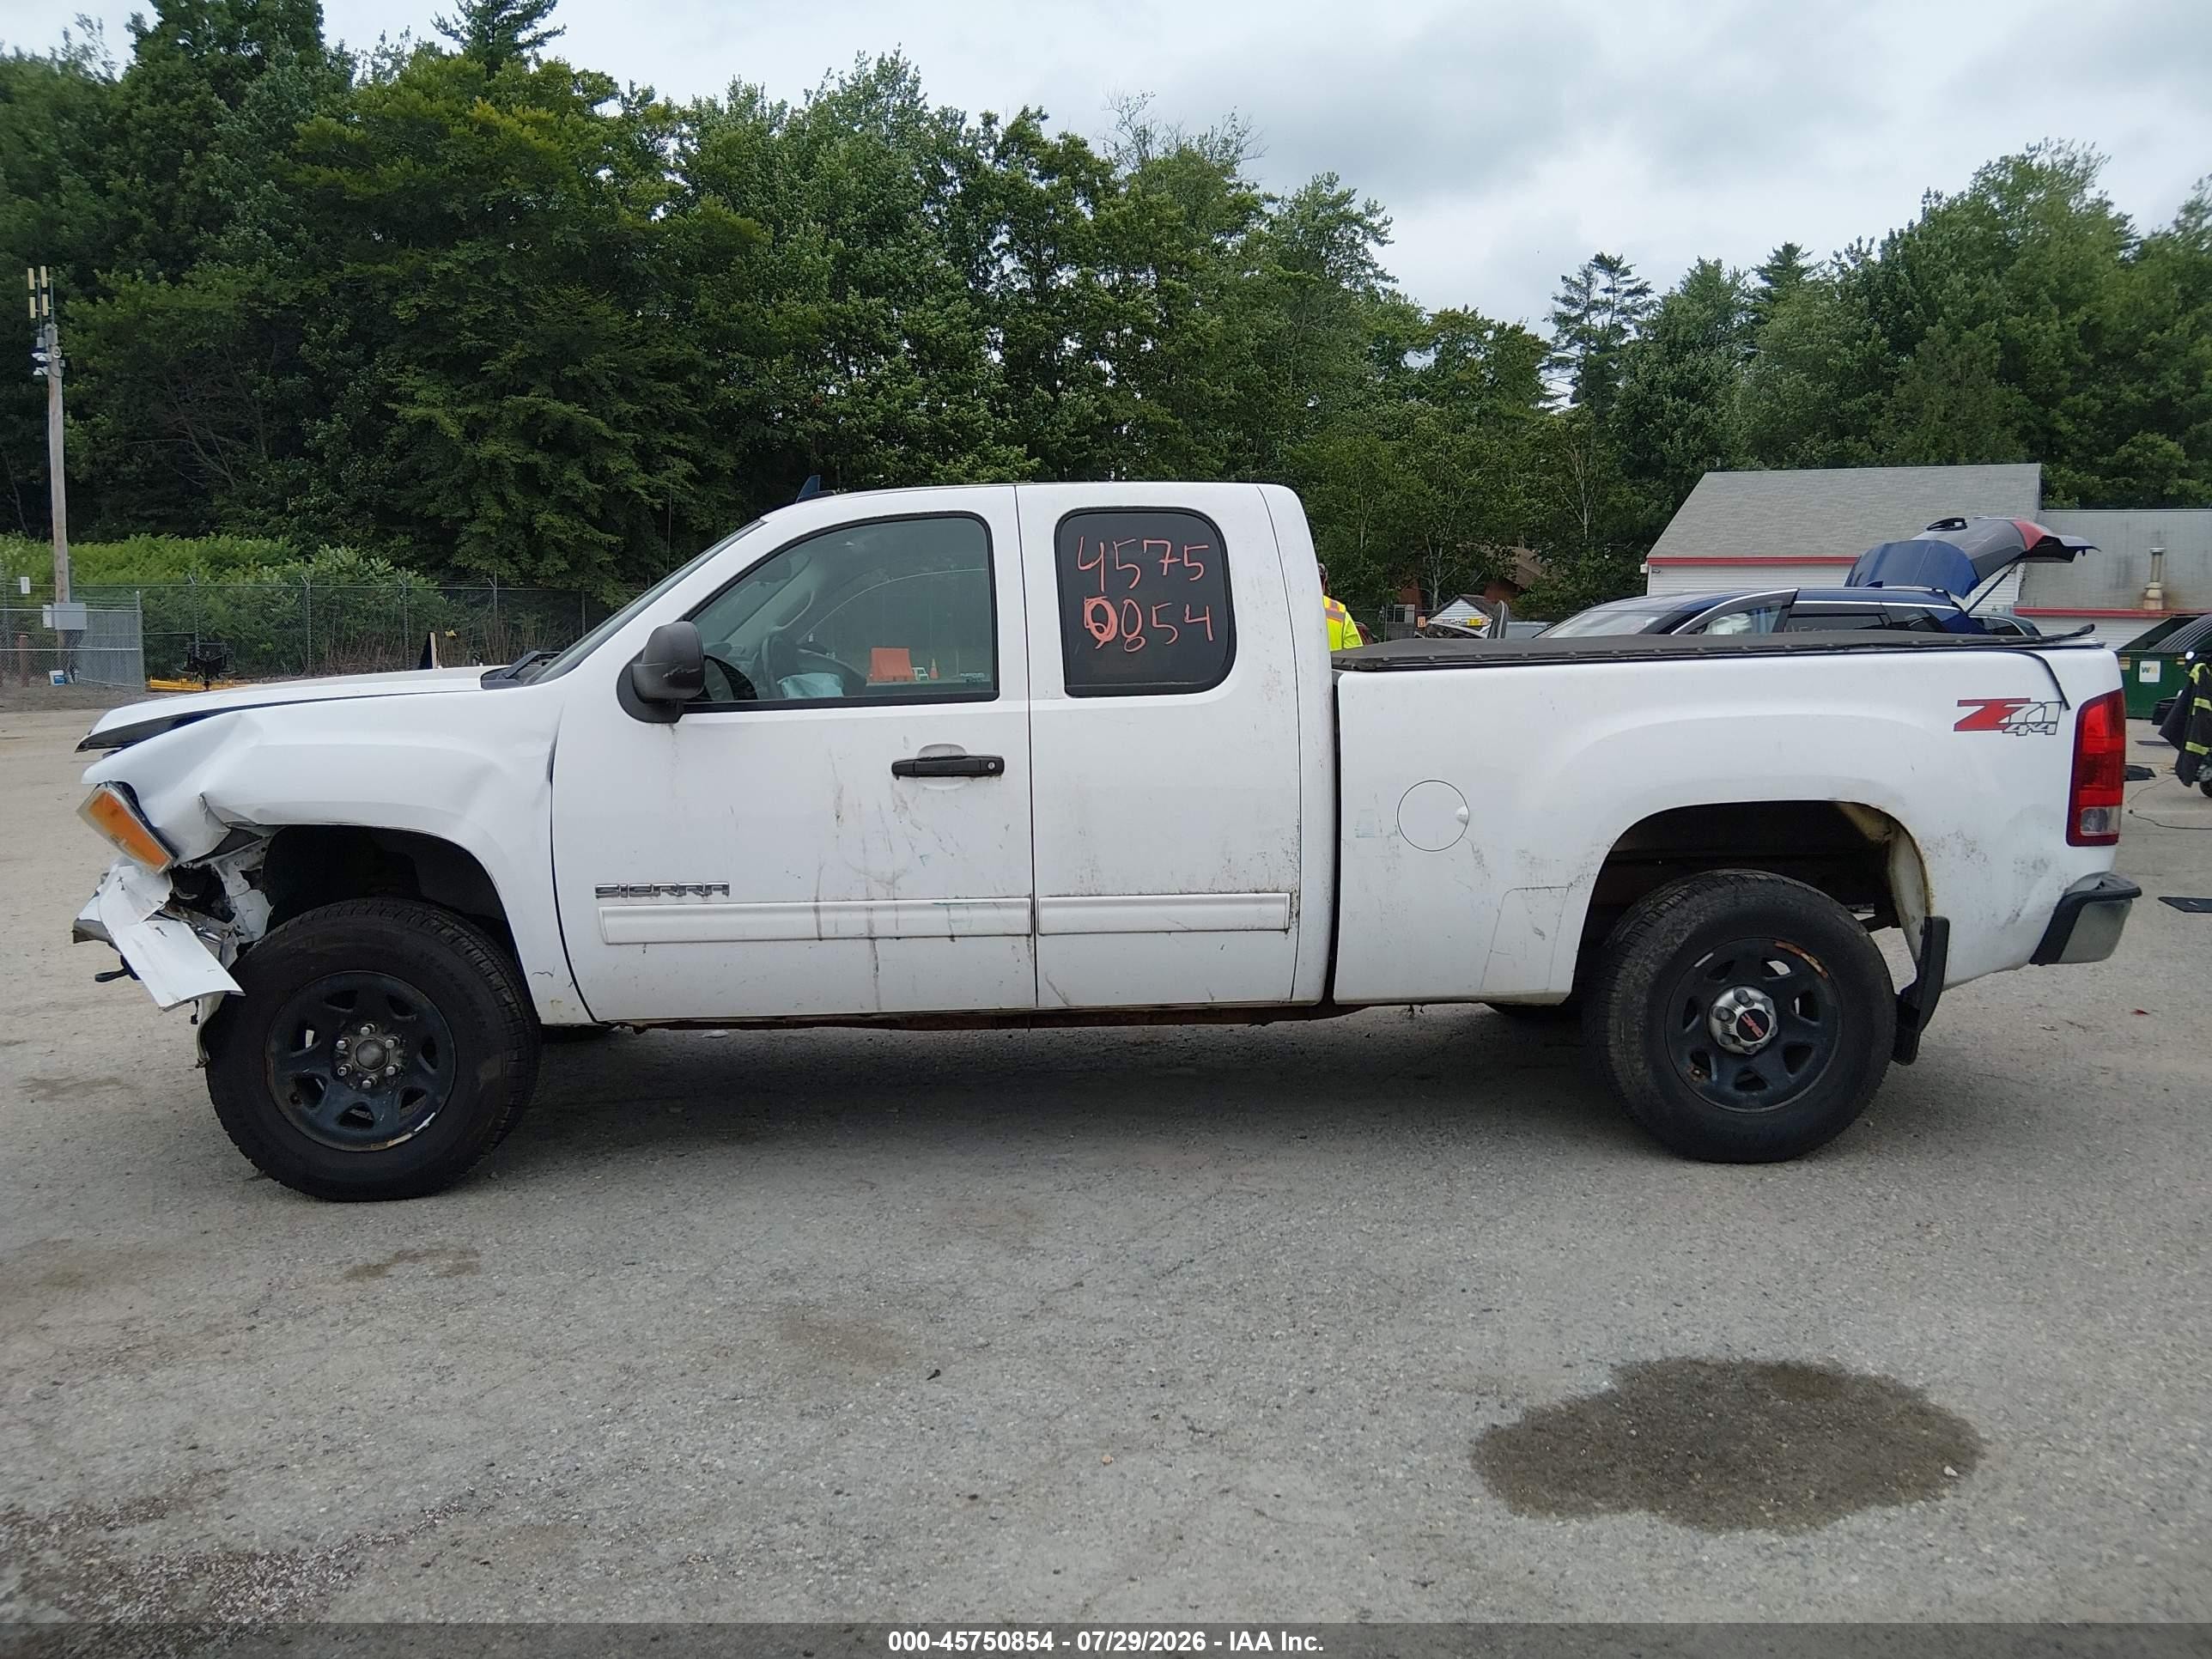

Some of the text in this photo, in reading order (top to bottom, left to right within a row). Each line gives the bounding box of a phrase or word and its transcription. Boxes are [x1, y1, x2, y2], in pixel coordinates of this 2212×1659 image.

[1077, 536, 1210, 592] 4575
[1954, 697, 2063, 732] Z71
[594, 882, 730, 899] SIERRA
